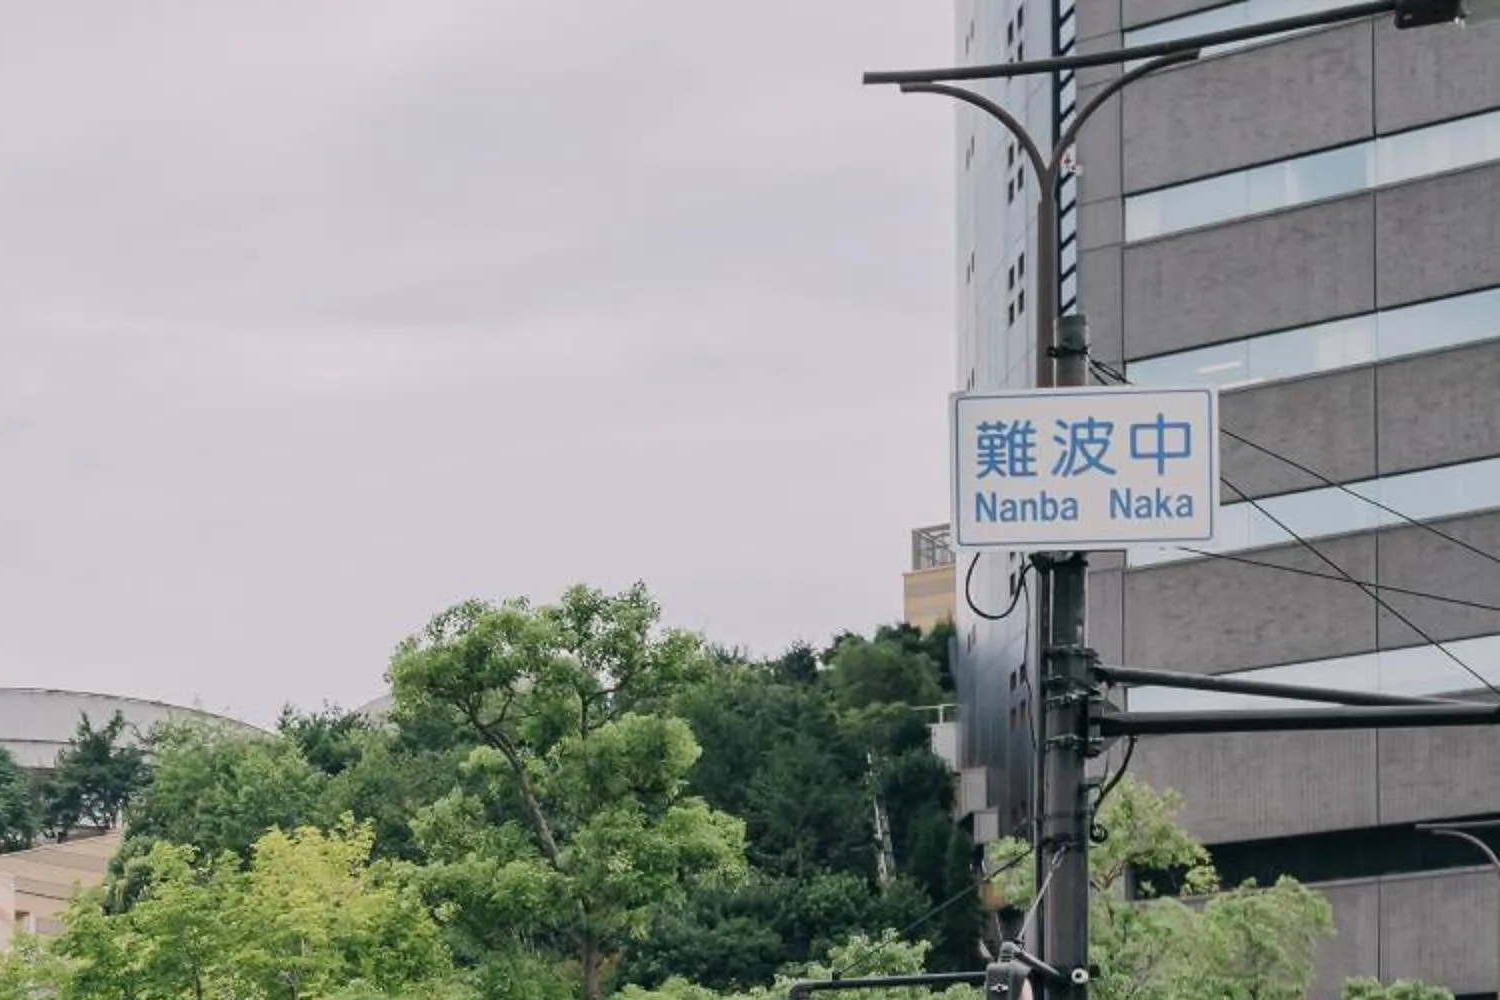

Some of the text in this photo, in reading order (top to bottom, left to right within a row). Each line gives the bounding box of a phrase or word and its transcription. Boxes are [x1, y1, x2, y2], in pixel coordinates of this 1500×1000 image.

[976, 413, 1192, 478] 難波中
[975, 488, 1194, 523] Nanba Naka
